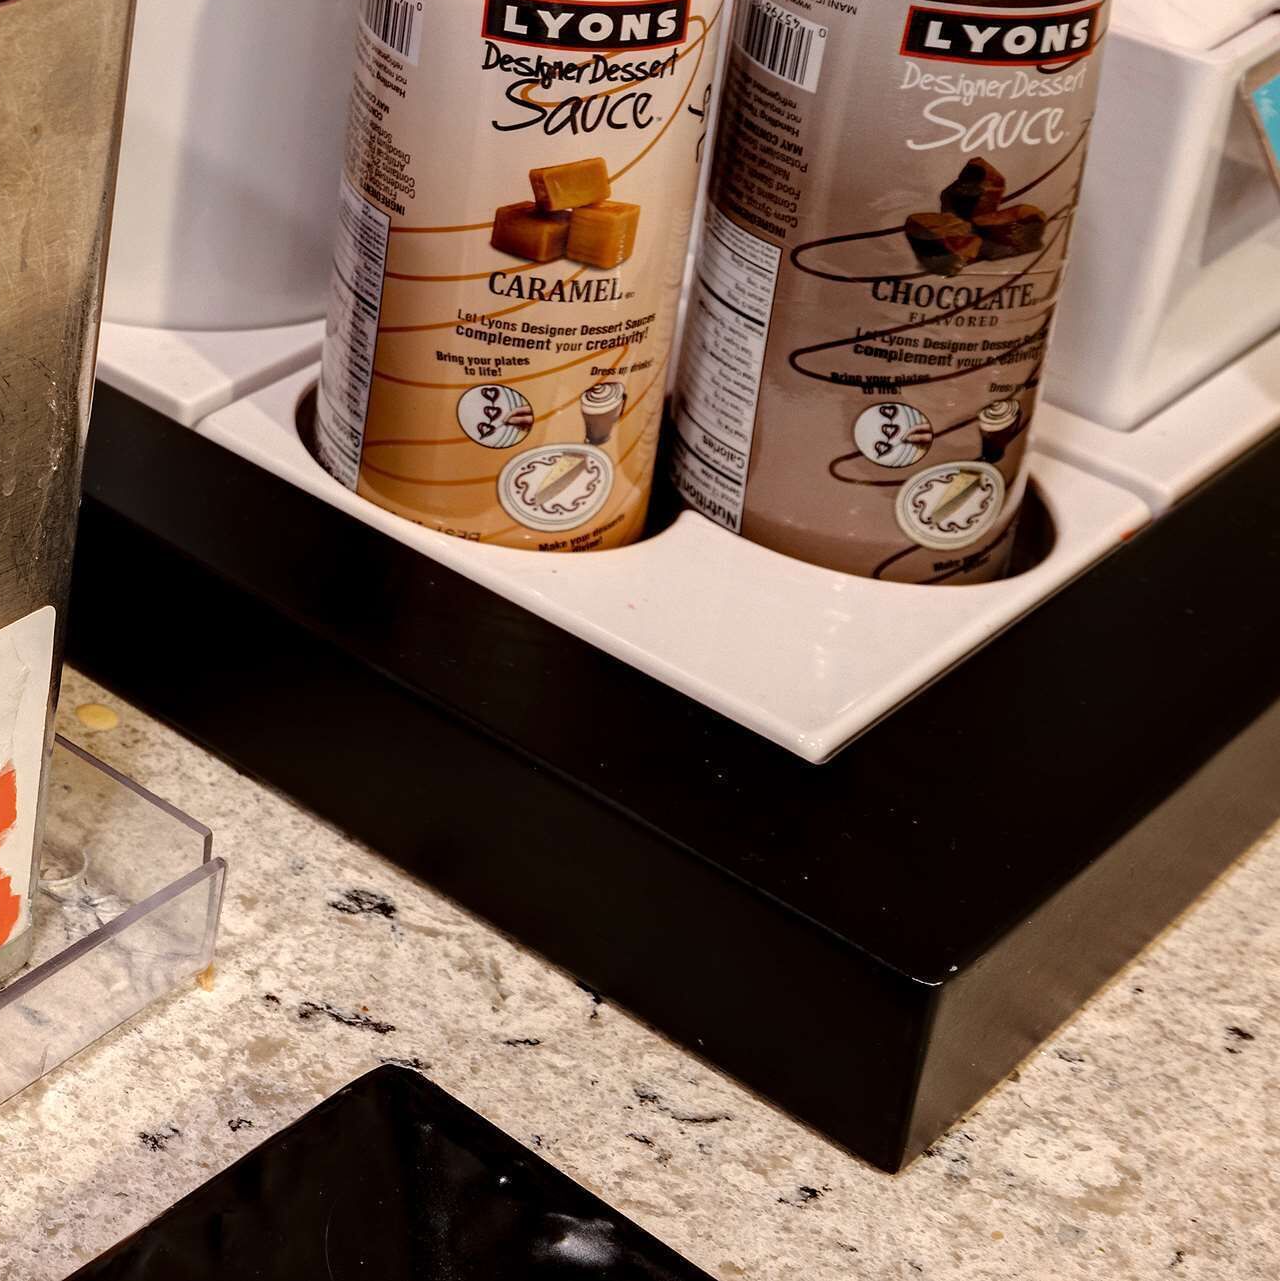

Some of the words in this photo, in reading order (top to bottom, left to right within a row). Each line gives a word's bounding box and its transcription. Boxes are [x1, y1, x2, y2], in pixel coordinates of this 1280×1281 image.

[503, 4, 678, 42] LYONS
[923, 18, 1090, 56] LYONS
[481, 40, 591, 90] Designer
[588, 47, 679, 85] Dessert
[899, 61, 1011, 107] Designer
[1009, 62, 1088, 100] Dessert
[491, 78, 654, 136] Sauce
[906, 95, 1065, 153] Sauce
[489, 271, 623, 303] CARAMEL
[871, 279, 1034, 311] CHOCOLATE
[455, 324, 551, 351] complement
[555, 342, 583, 354] your
[585, 327, 650, 351] creativity!
[481, 314, 518, 332] Lyons
[520, 322, 577, 338] Designer
[580, 322, 623, 336] Dessert
[435, 350, 465, 366] Bring
[467, 355, 492, 367] your
[494, 355, 531, 367] plates
[852, 342, 954, 368] complement
[881, 333, 919, 349] Lyons
[923, 336, 979, 353] Designer
[464, 365, 475, 376] to
[478, 365, 503, 377] life!
[703, 435, 746, 470] Calories
[683, 479, 738, 529] Nutrition
